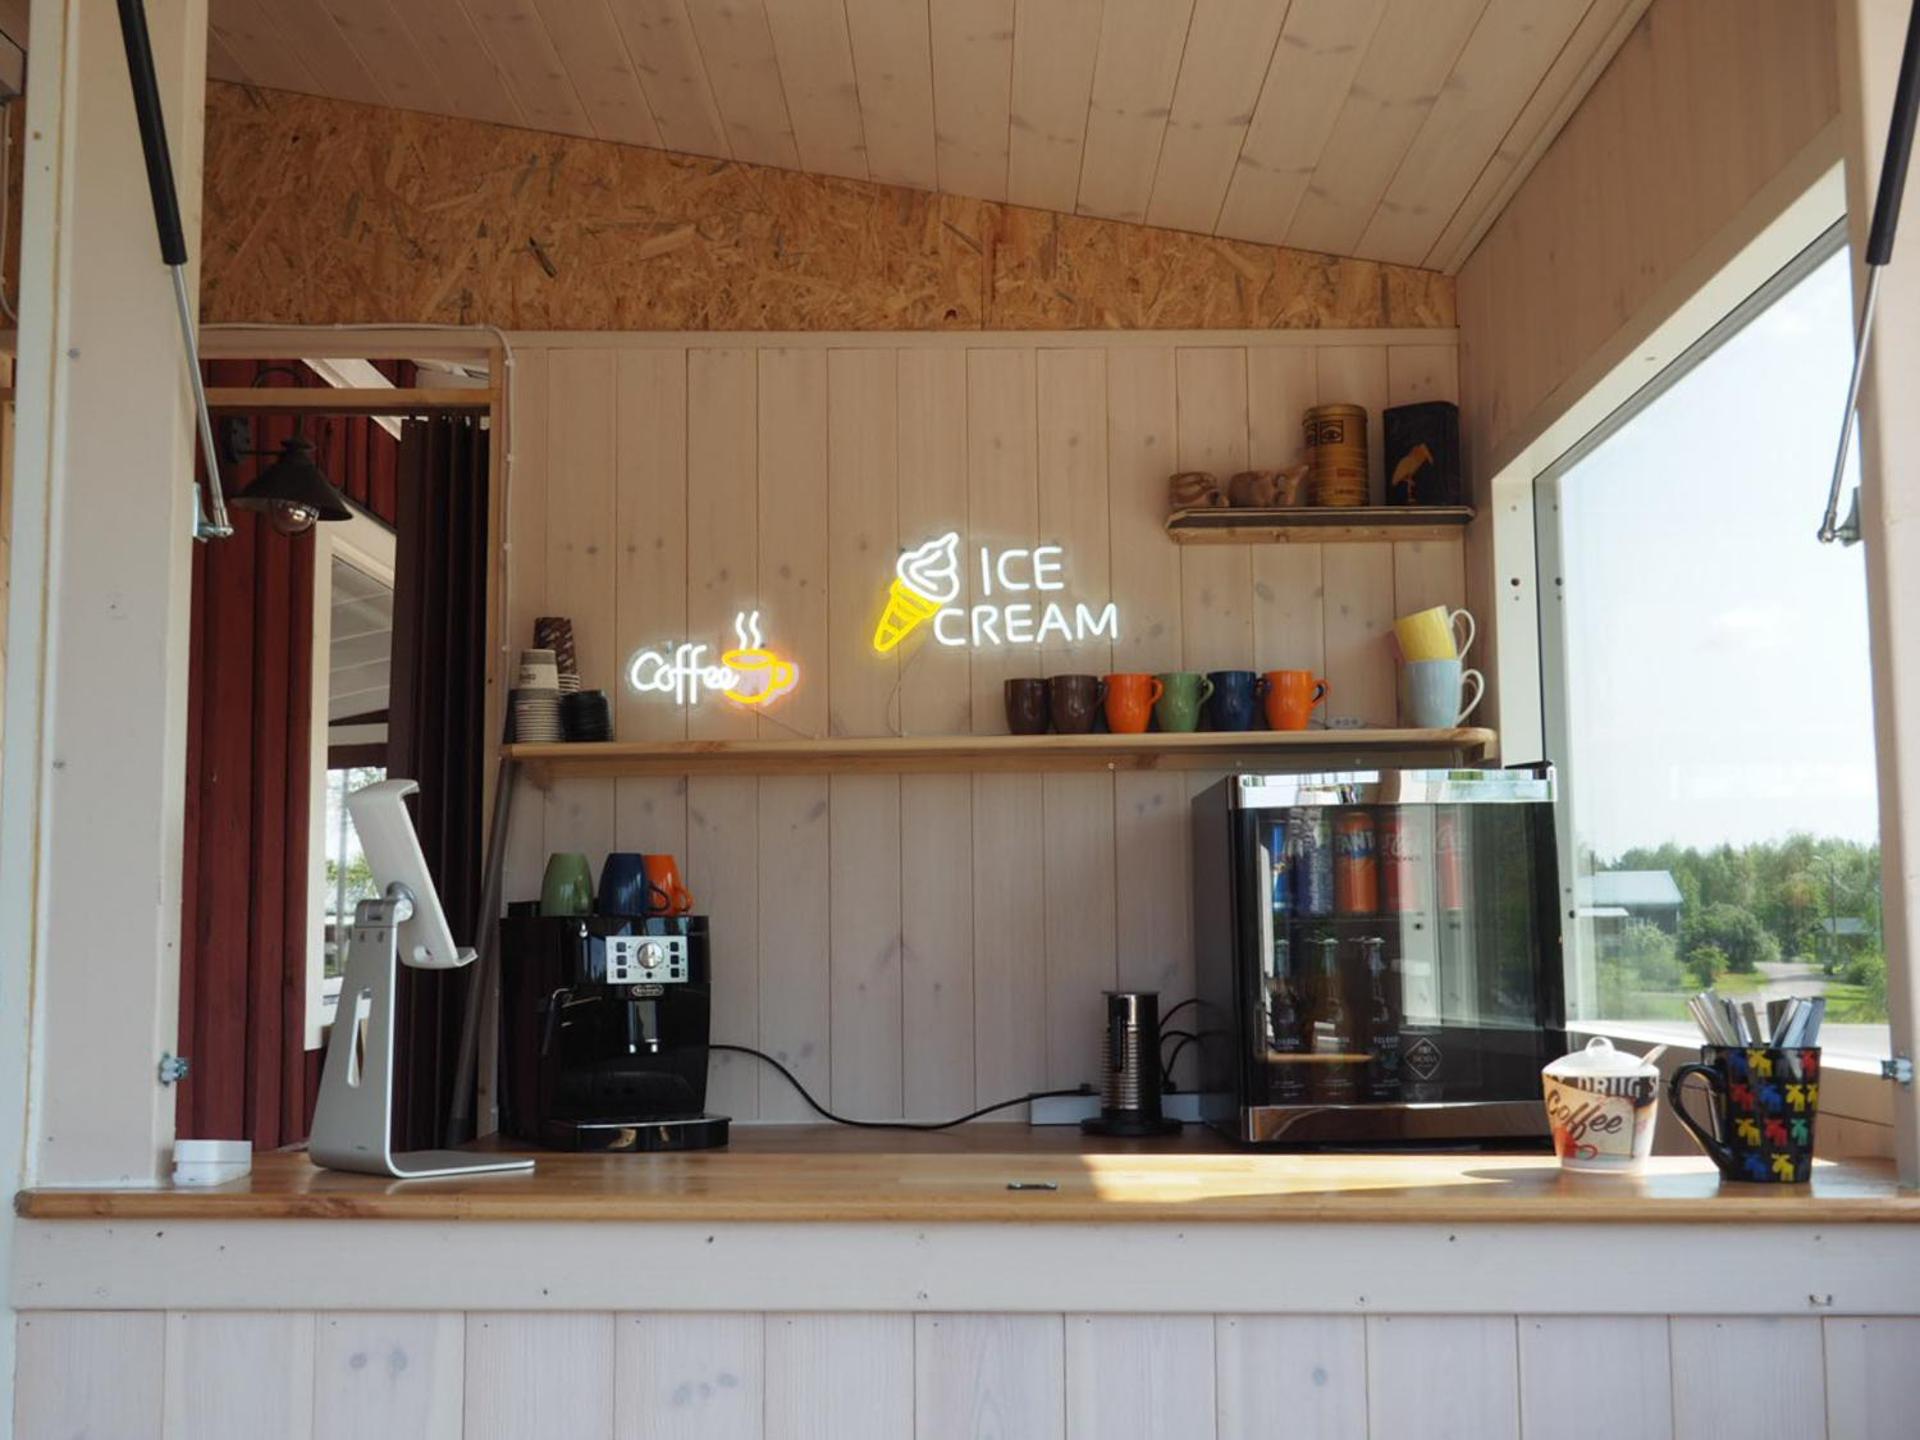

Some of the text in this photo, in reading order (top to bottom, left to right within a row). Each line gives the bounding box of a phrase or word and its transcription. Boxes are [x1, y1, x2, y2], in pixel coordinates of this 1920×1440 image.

[981, 547, 1064, 596] ICE
[933, 603, 1117, 646] CREAM
[631, 643, 740, 704] Coffee
[1547, 1089, 1622, 1140] Coffee
